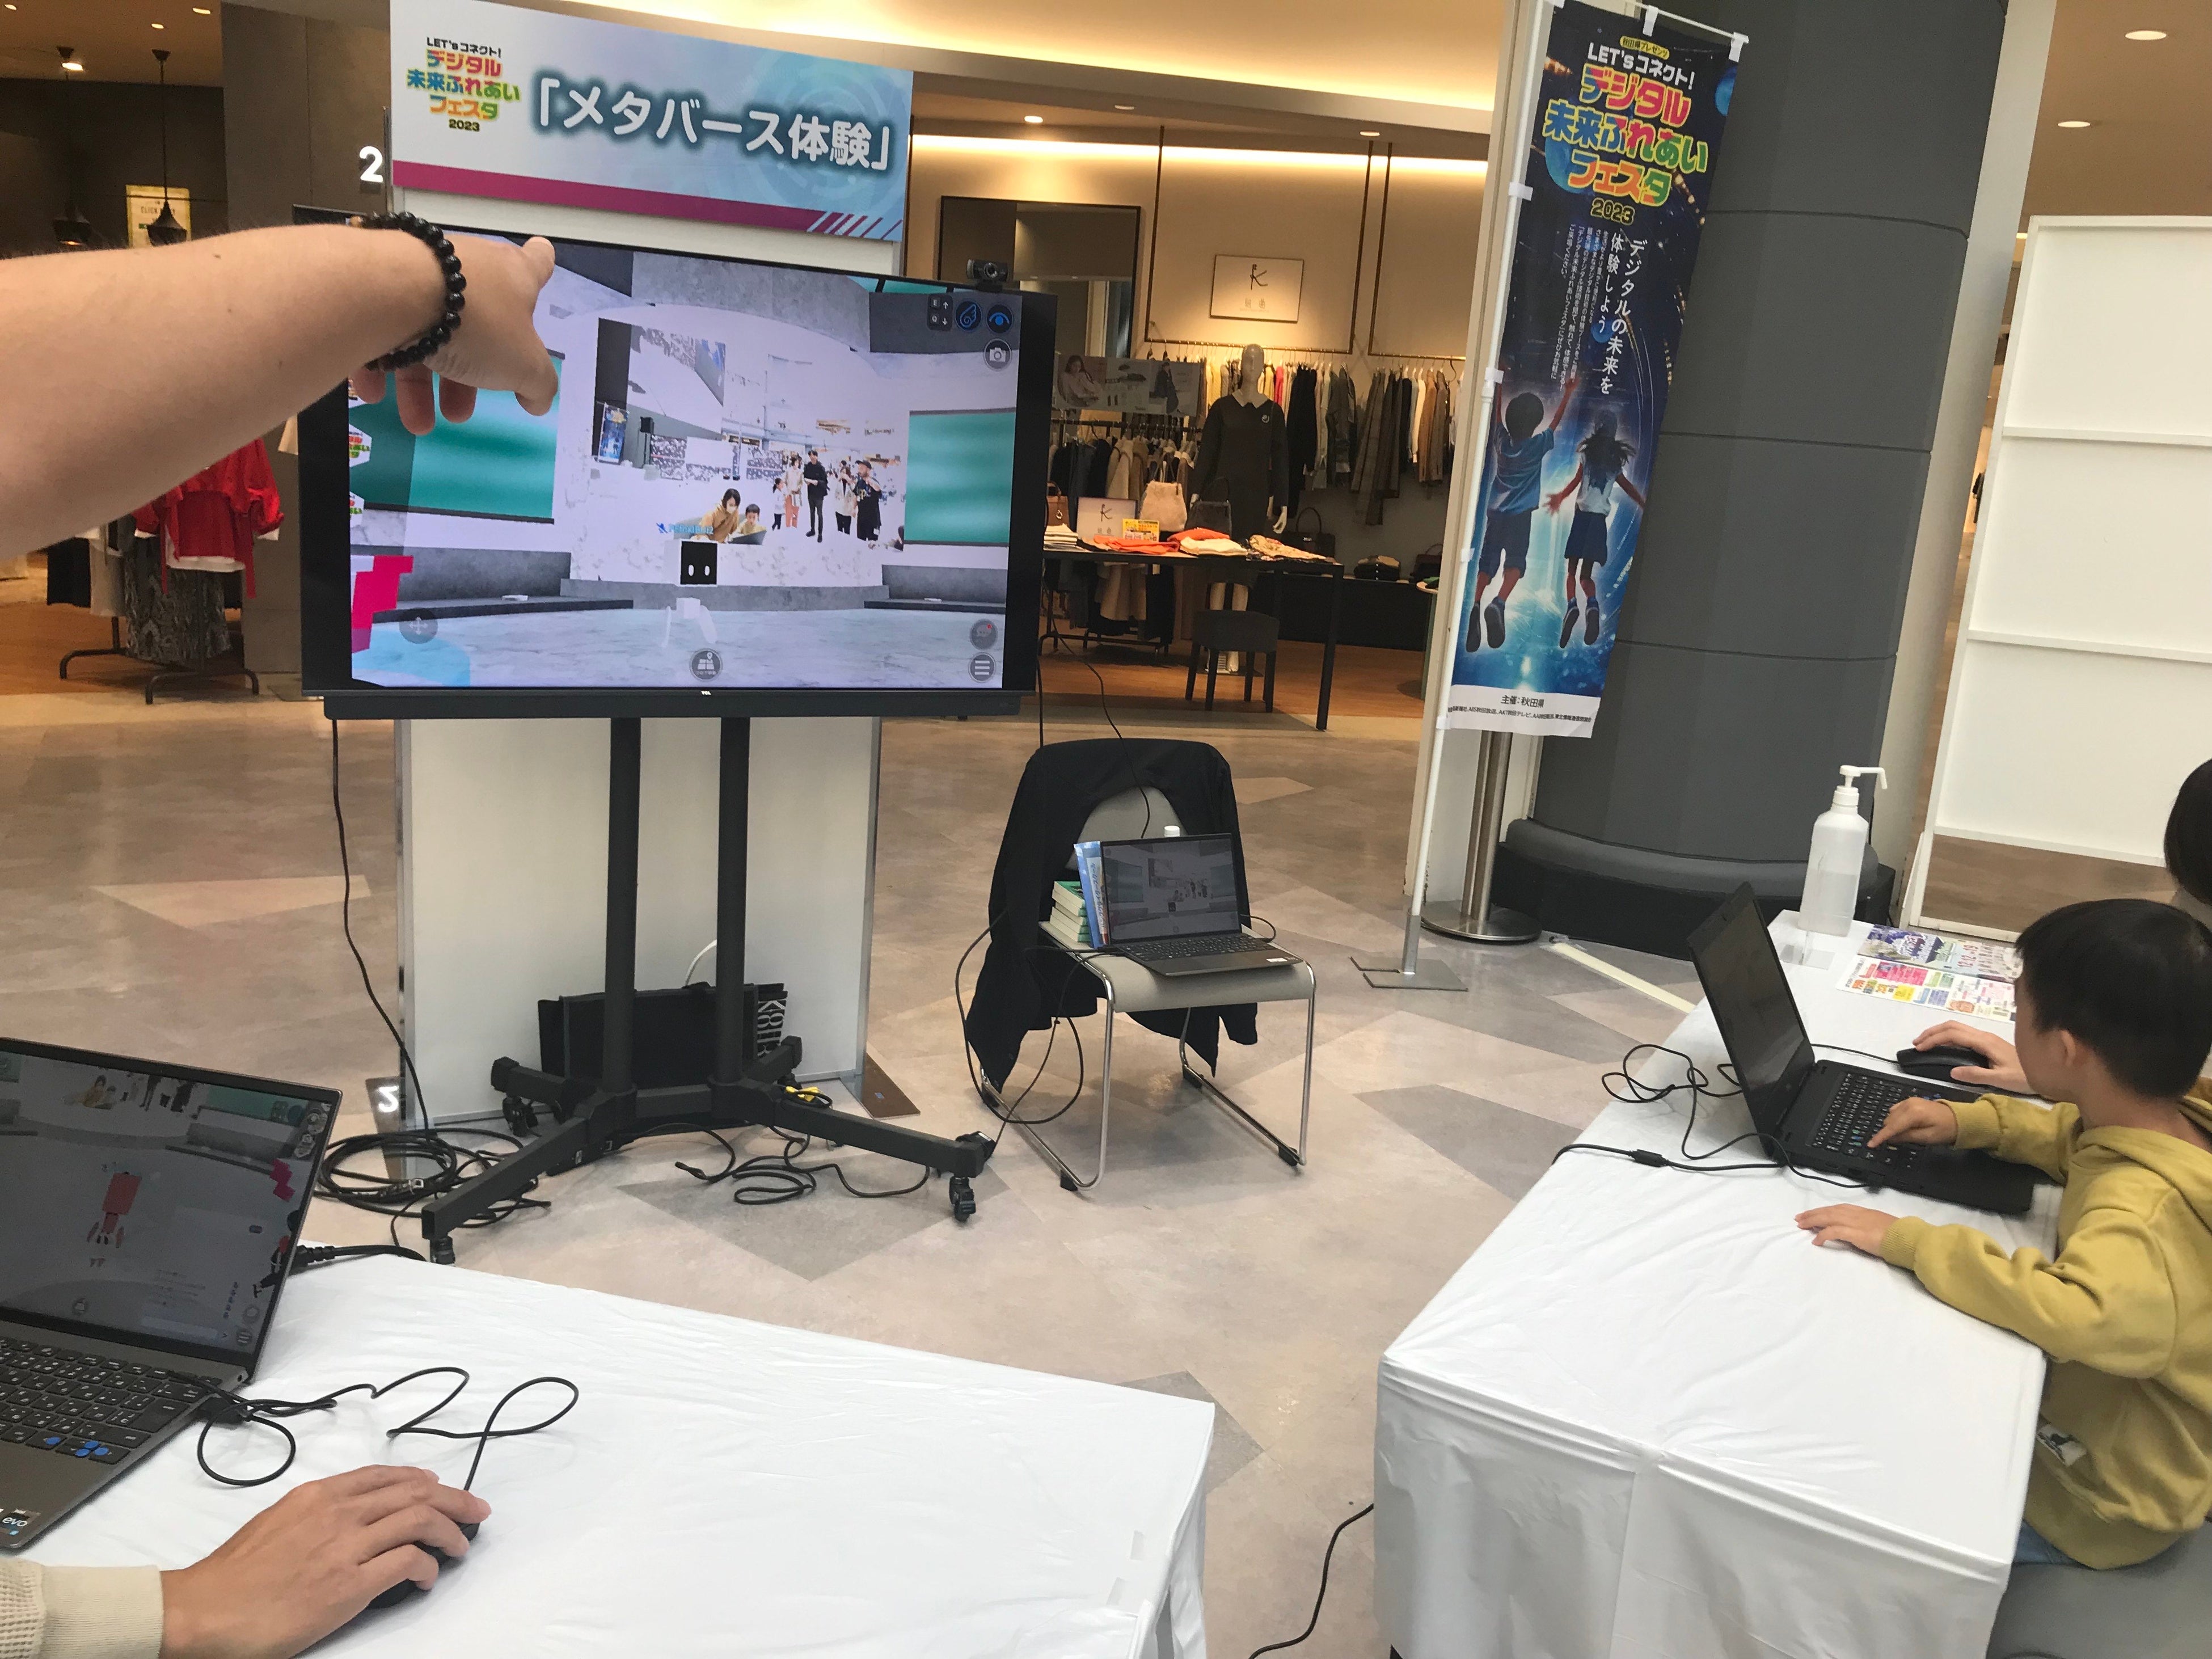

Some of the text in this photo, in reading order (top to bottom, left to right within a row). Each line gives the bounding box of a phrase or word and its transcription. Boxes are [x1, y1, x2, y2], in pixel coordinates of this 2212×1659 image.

[427, 49, 501, 77] デジタル
[407, 69, 520, 101] 未来ふれあい
[1580, 64, 1691, 127] デジタル
[430, 94, 498, 120] フェスタ
[449, 119, 480, 132] 2023
[540, 78, 890, 171] 「メタバース体験」
[1542, 99, 1708, 173] 未来ふれあい
[359, 146, 383, 183] 2
[1568, 149, 1671, 206] フェスタ
[1590, 198, 1635, 225] 2023
[1598, 233, 1624, 334] 体験しよう
[1601, 239, 1648, 394] デジタルの未来を
[1501, 695, 1544, 708] 主催:秋田県
[2, 1517, 28, 1527] evo
